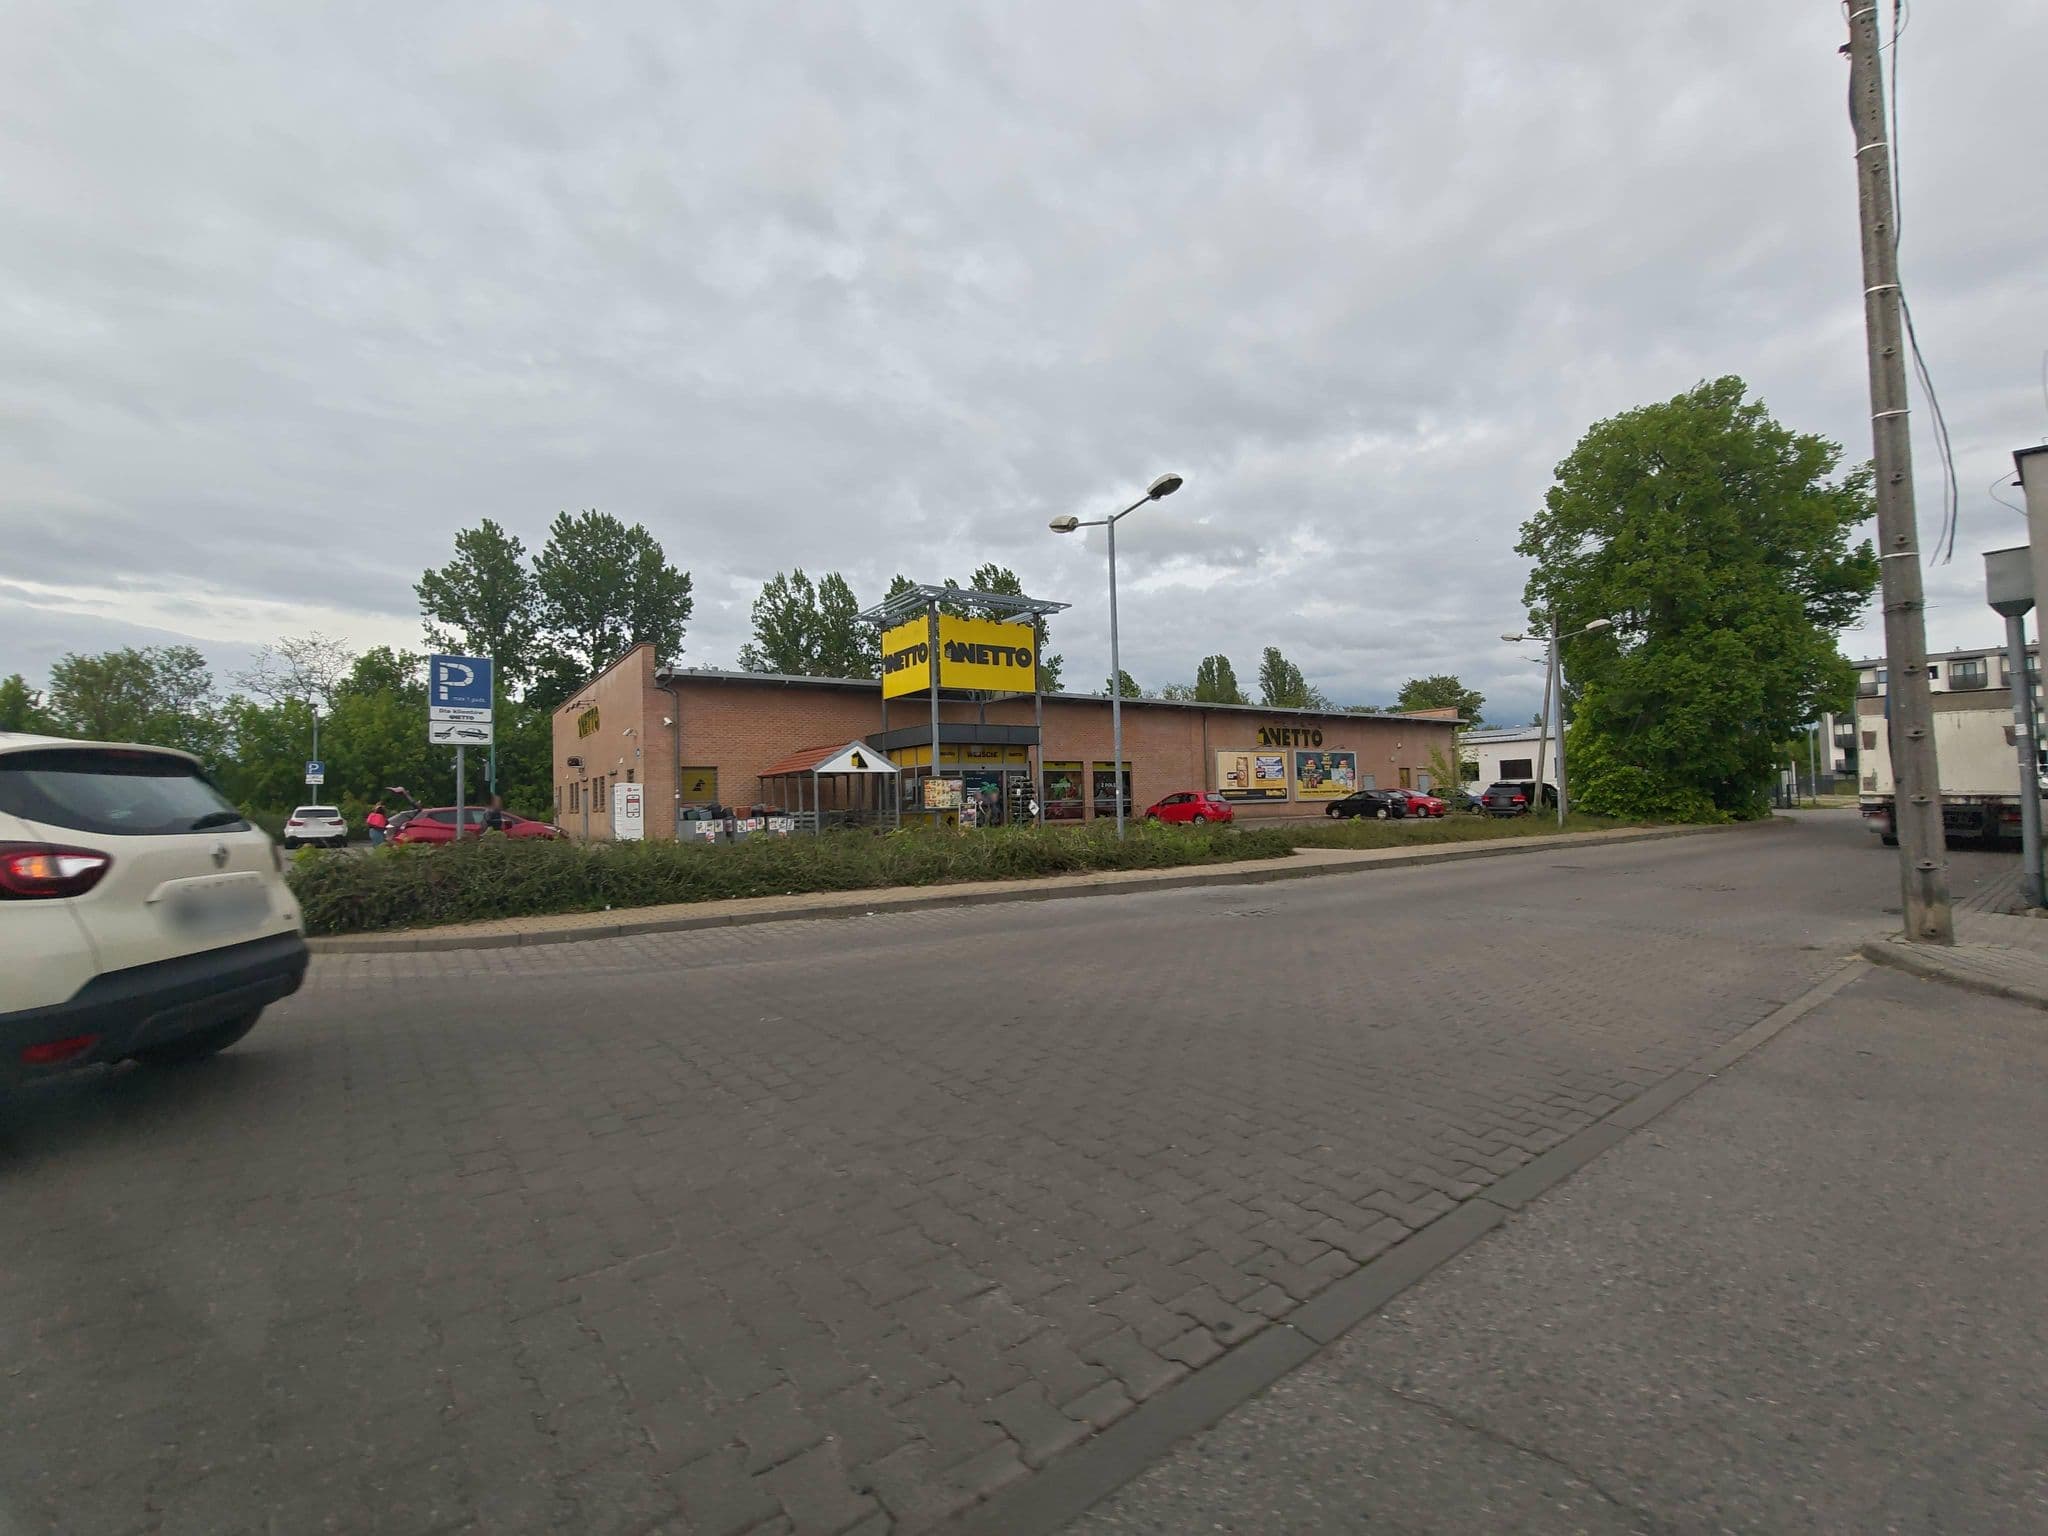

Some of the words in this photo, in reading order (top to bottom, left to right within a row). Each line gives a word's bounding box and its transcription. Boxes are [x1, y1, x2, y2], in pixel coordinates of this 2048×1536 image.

[886, 642, 928, 674] NETTO
[949, 643, 1032, 668] NETTO
[439, 662, 474, 700] P
[1264, 727, 1323, 747] NETTO
[308, 763, 320, 774] P
